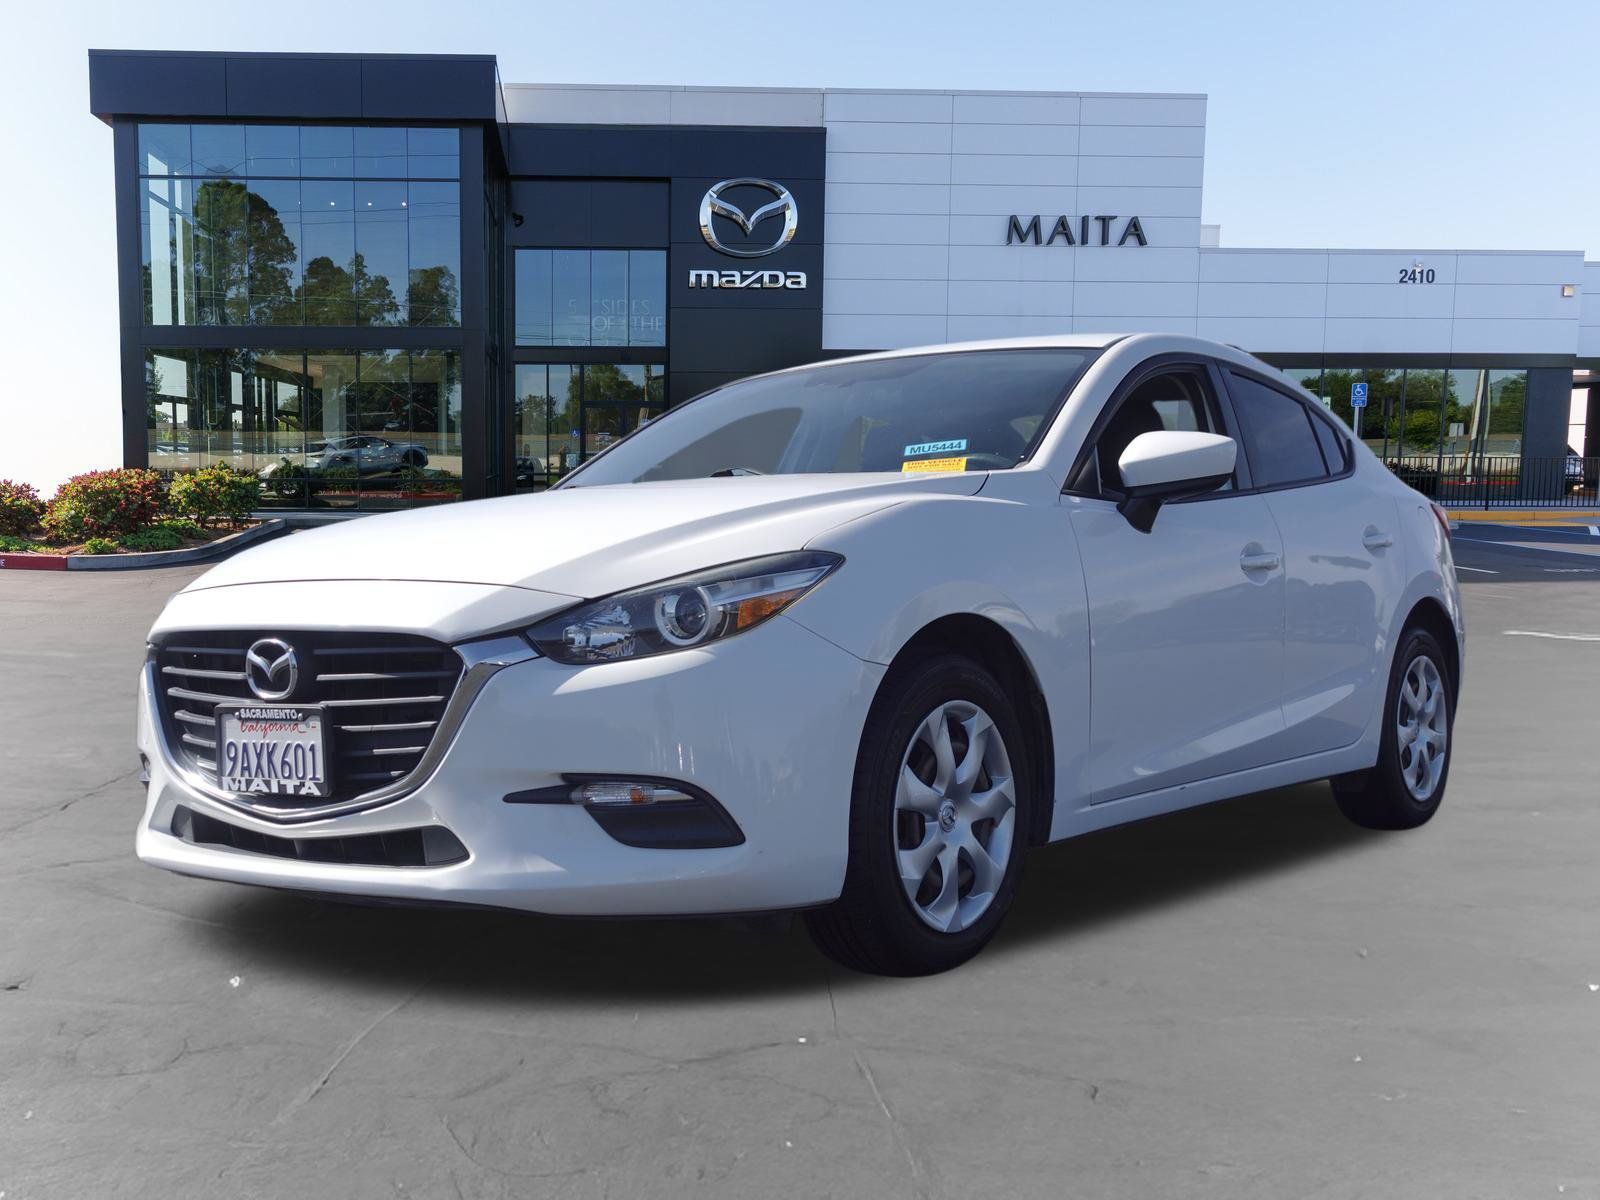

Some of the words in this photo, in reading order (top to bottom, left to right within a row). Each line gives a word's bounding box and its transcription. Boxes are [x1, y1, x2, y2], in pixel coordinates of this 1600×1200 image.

[1006, 215, 1148, 246] MAITA
[1399, 268, 1436, 284] 2410
[910, 440, 962, 454] MU5444
[240, 708, 298, 720] SACRAMENTO
[240, 720, 307, 739] California
[226, 741, 320, 781] 9AXK601
[222, 777, 322, 796] MAITA
